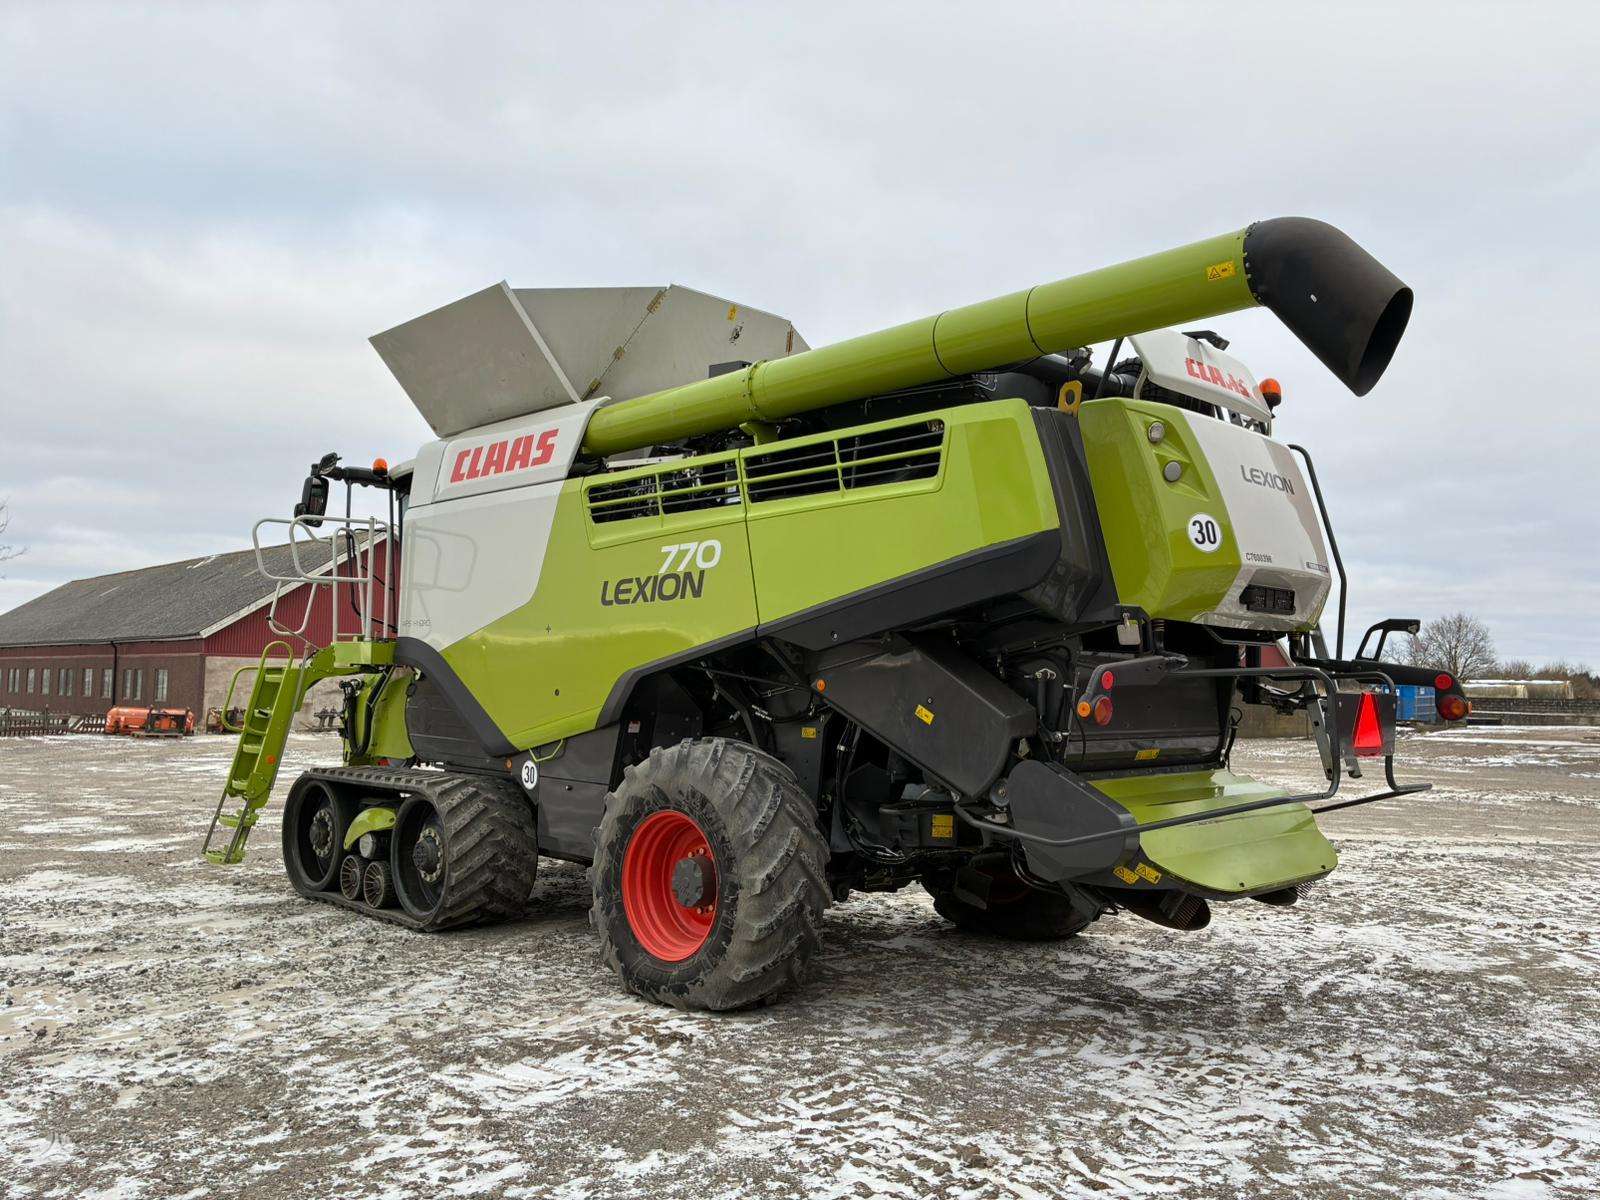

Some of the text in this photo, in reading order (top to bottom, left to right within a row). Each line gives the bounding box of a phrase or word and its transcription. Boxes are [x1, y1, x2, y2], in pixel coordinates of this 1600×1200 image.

[1185, 357, 1250, 398] CLAAS
[450, 428, 560, 483] CLAAS
[1240, 464, 1295, 495] LEXION
[1191, 520, 1217, 545] 30
[658, 539, 722, 574] 770
[600, 570, 705, 607] LEXION
[524, 765, 535, 784] 30
